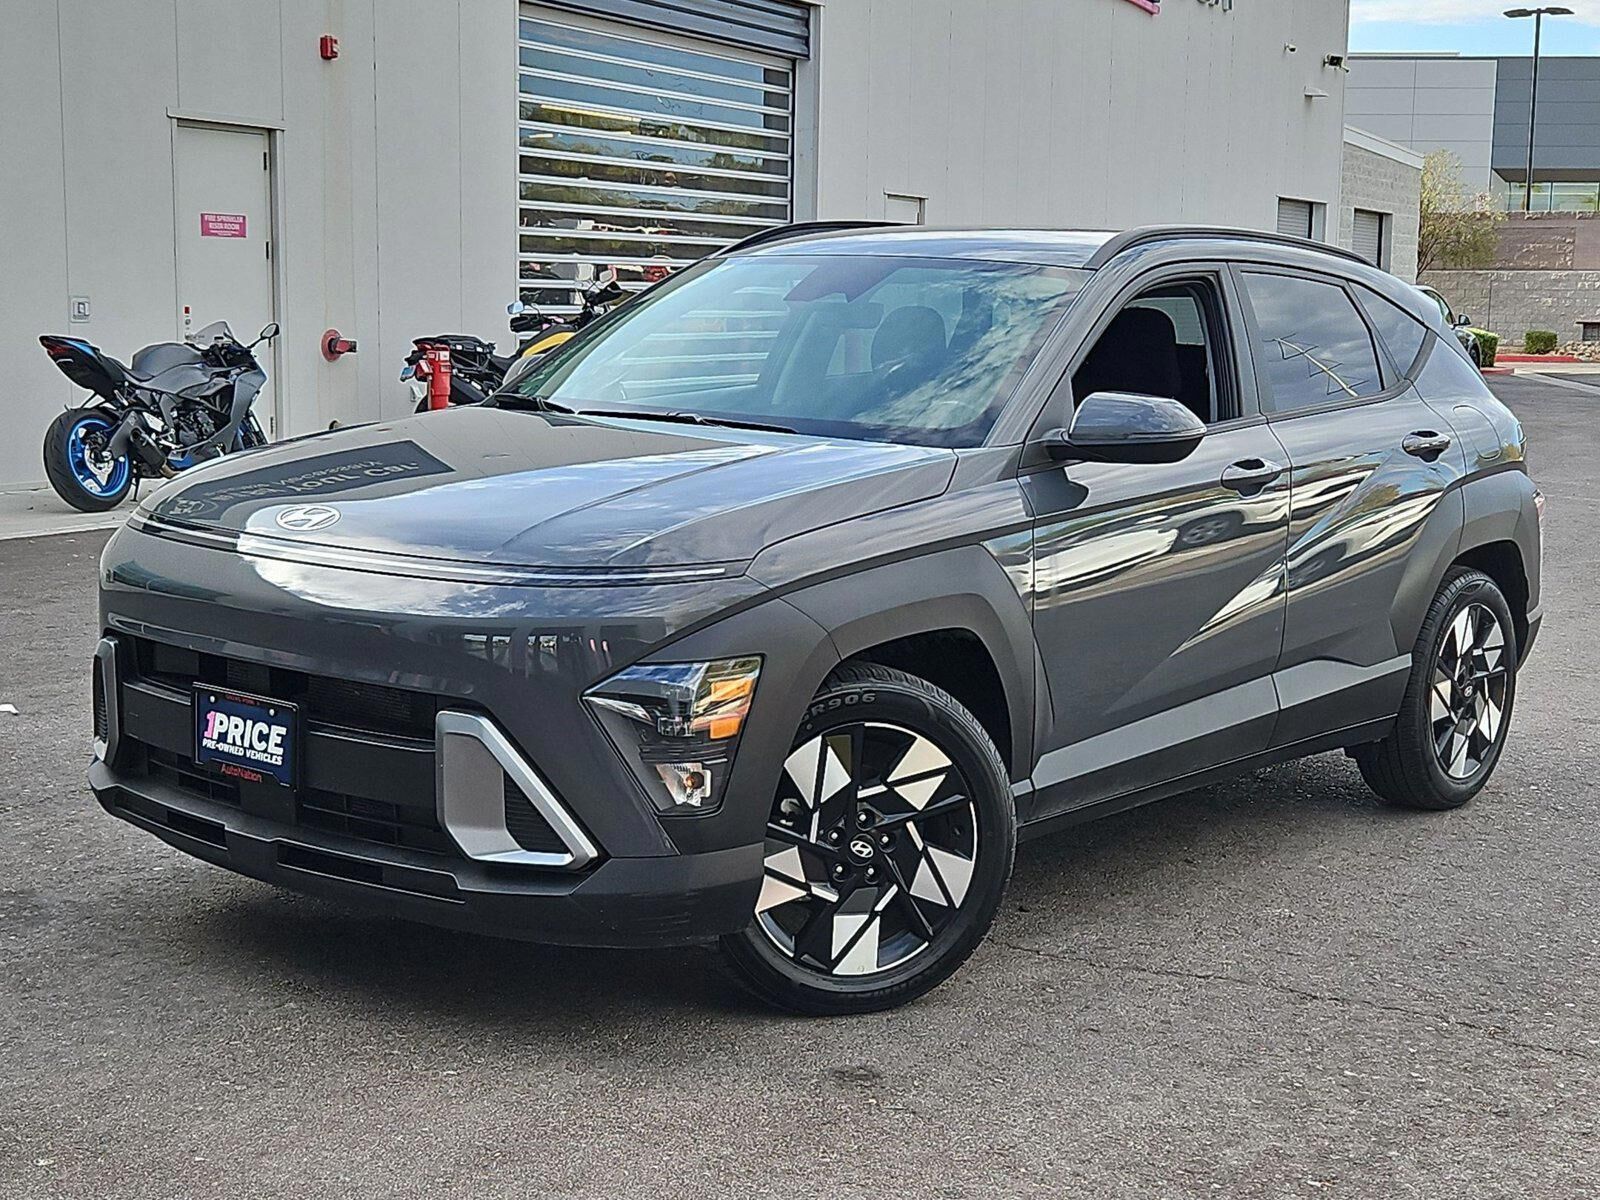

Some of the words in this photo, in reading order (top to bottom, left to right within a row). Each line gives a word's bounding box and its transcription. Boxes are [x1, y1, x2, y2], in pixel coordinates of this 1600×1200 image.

[202, 738, 244, 756] PRE-OWNED
[245, 749, 283, 765] VEHICLES
[221, 764, 262, 782] AutoNation
